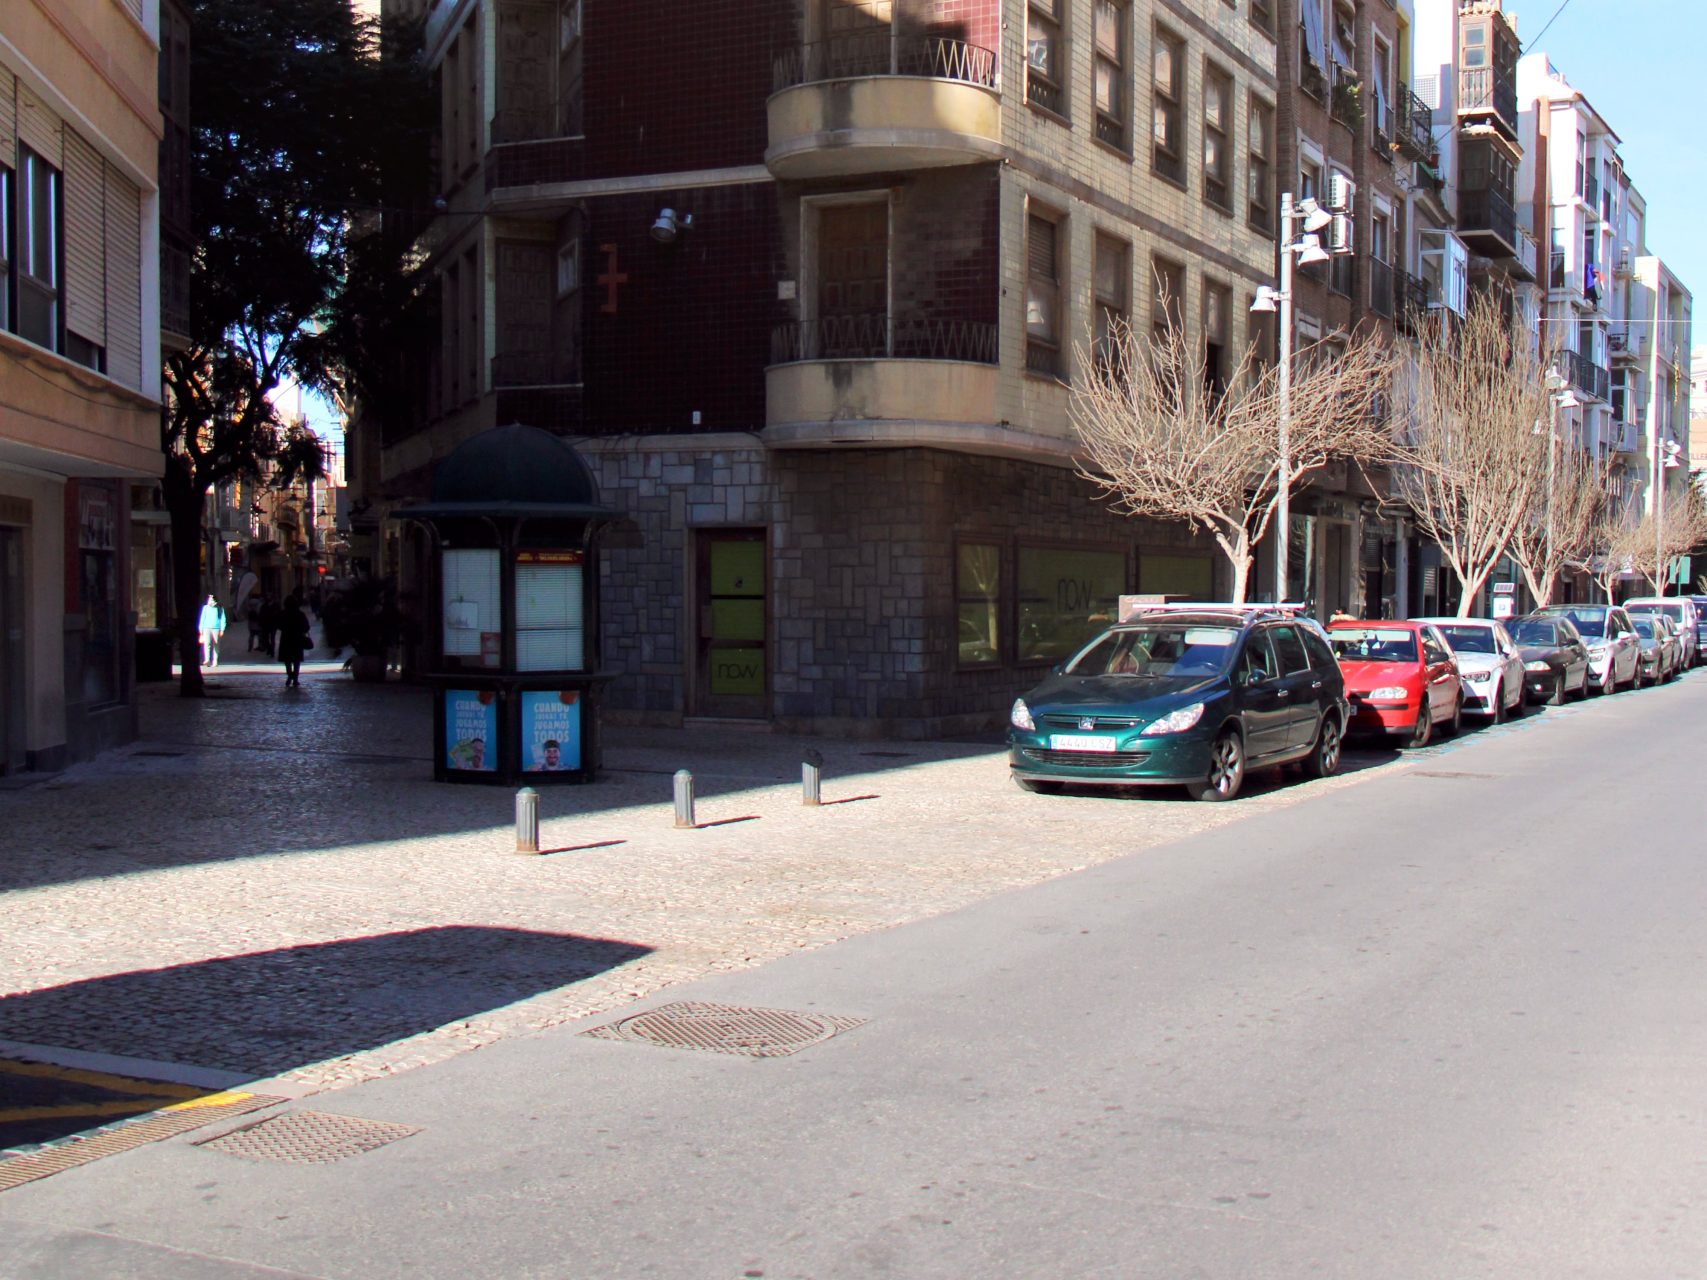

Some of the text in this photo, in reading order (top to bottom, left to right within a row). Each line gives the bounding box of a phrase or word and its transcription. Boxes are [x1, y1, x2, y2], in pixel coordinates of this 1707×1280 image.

[717, 663, 758, 680] now
[533, 703, 570, 713] CUANDO
[534, 720, 570, 730] JUGAMOS
[455, 728, 487, 742] TODOS
[533, 730, 570, 743] TODOS
